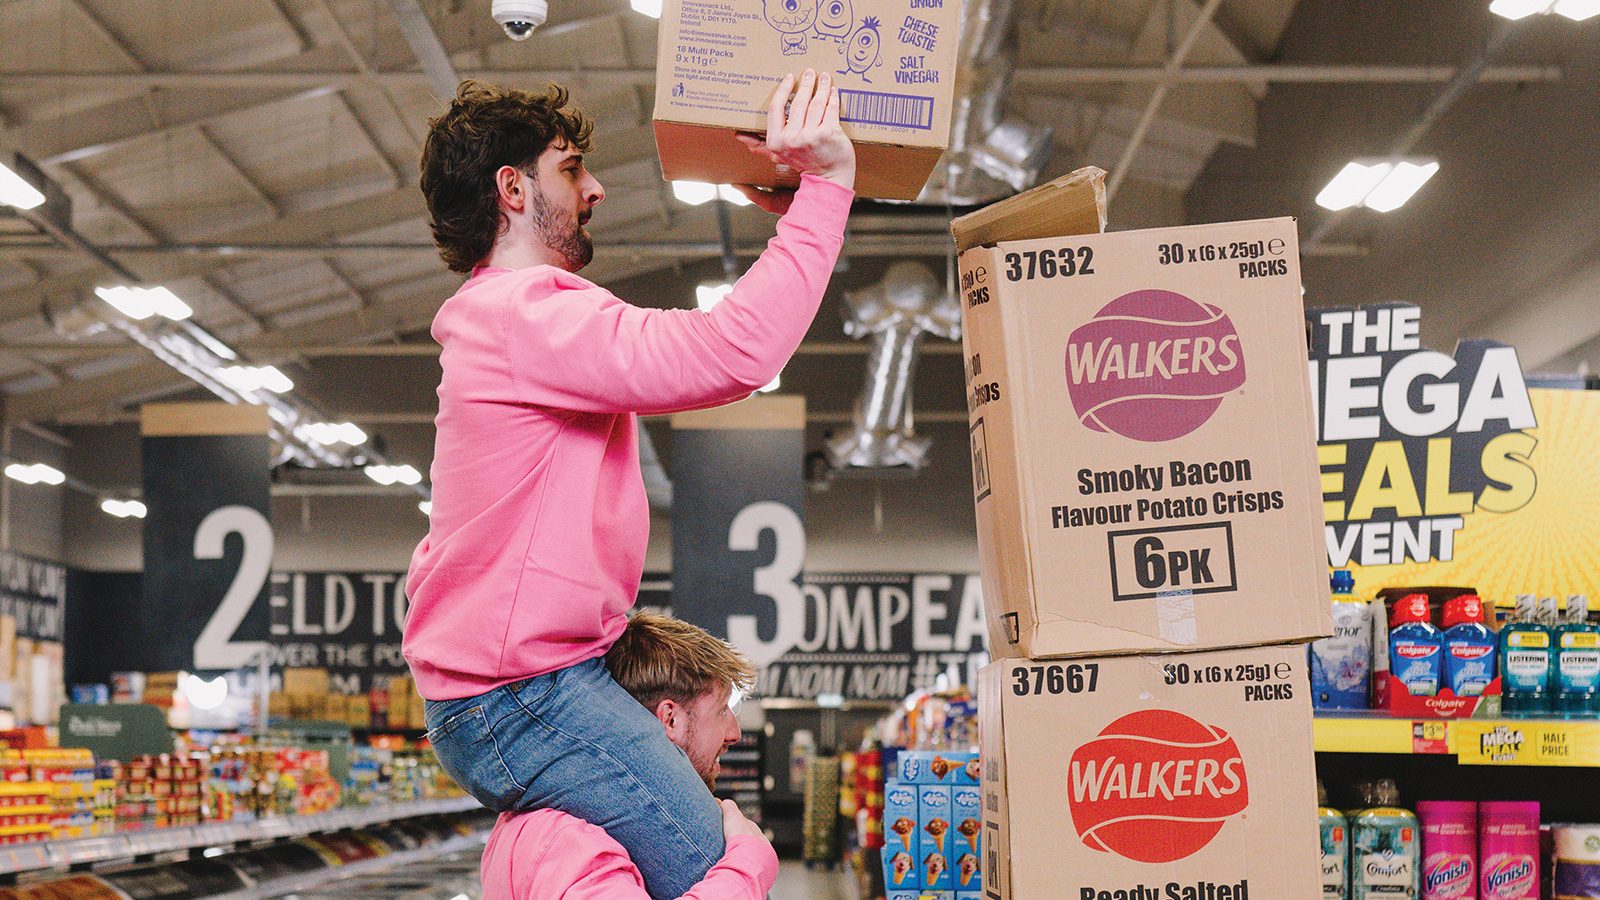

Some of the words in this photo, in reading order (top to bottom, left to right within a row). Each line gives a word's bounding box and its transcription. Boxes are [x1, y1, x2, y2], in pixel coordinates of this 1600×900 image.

[897, 27, 937, 52] TOASTIE
[904, 15, 939, 39] CHEESE
[679, 36, 747, 47] www.innovasnack.com
[688, 46, 708, 55] Multi
[710, 48, 734, 58] Packs
[675, 54, 682, 63] 9
[900, 55, 925, 70] SALT
[894, 70, 939, 85] VINEGAR
[1004, 246, 1095, 283] 37632
[1158, 243, 1184, 265] 30
[1188, 249, 1198, 263] x
[1200, 245, 1215, 261] (6
[1218, 246, 1227, 260] x
[1229, 240, 1264, 259] 25g)
[1239, 258, 1288, 279] PACKS
[1320, 306, 1421, 355] THE
[1068, 334, 1238, 386] WALKERS
[1308, 346, 1539, 442] EGA
[1077, 464, 1164, 496] Smoky
[1169, 458, 1252, 487] Bacon
[1317, 431, 1540, 522] EALS
[1051, 503, 1132, 529] Flavour
[1137, 496, 1208, 522] Potato
[1212, 489, 1285, 515] Crisps
[1325, 517, 1465, 568] VENT
[1132, 535, 1215, 590] 6PK
[193, 505, 274, 670] 2
[727, 501, 806, 669] 3
[270, 573, 356, 635] ELD
[801, 585, 909, 651] OMP
[1397, 646, 1431, 656] Colgate
[1451, 646, 1485, 656] Colgate
[1011, 663, 1099, 697] 37667
[1163, 663, 1189, 685] 30
[1193, 669, 1203, 684] x
[1205, 665, 1221, 682] (6
[1224, 668, 1233, 682] x
[1235, 664, 1270, 682] 25g)
[1245, 683, 1293, 701] PACKS
[1425, 698, 1467, 709] Colgate
[1483, 731, 1524, 746] MEGA
[1541, 745, 1570, 756] PRICE
[1543, 733, 1566, 743] HALF
[1070, 755, 1242, 803] WALKERS
[1366, 862, 1408, 878] Comfort
[1426, 860, 1469, 893] Vanish
[1487, 861, 1530, 893] Vanish
[1079, 883, 1160, 900] Ready
[1165, 879, 1249, 900] Salted
